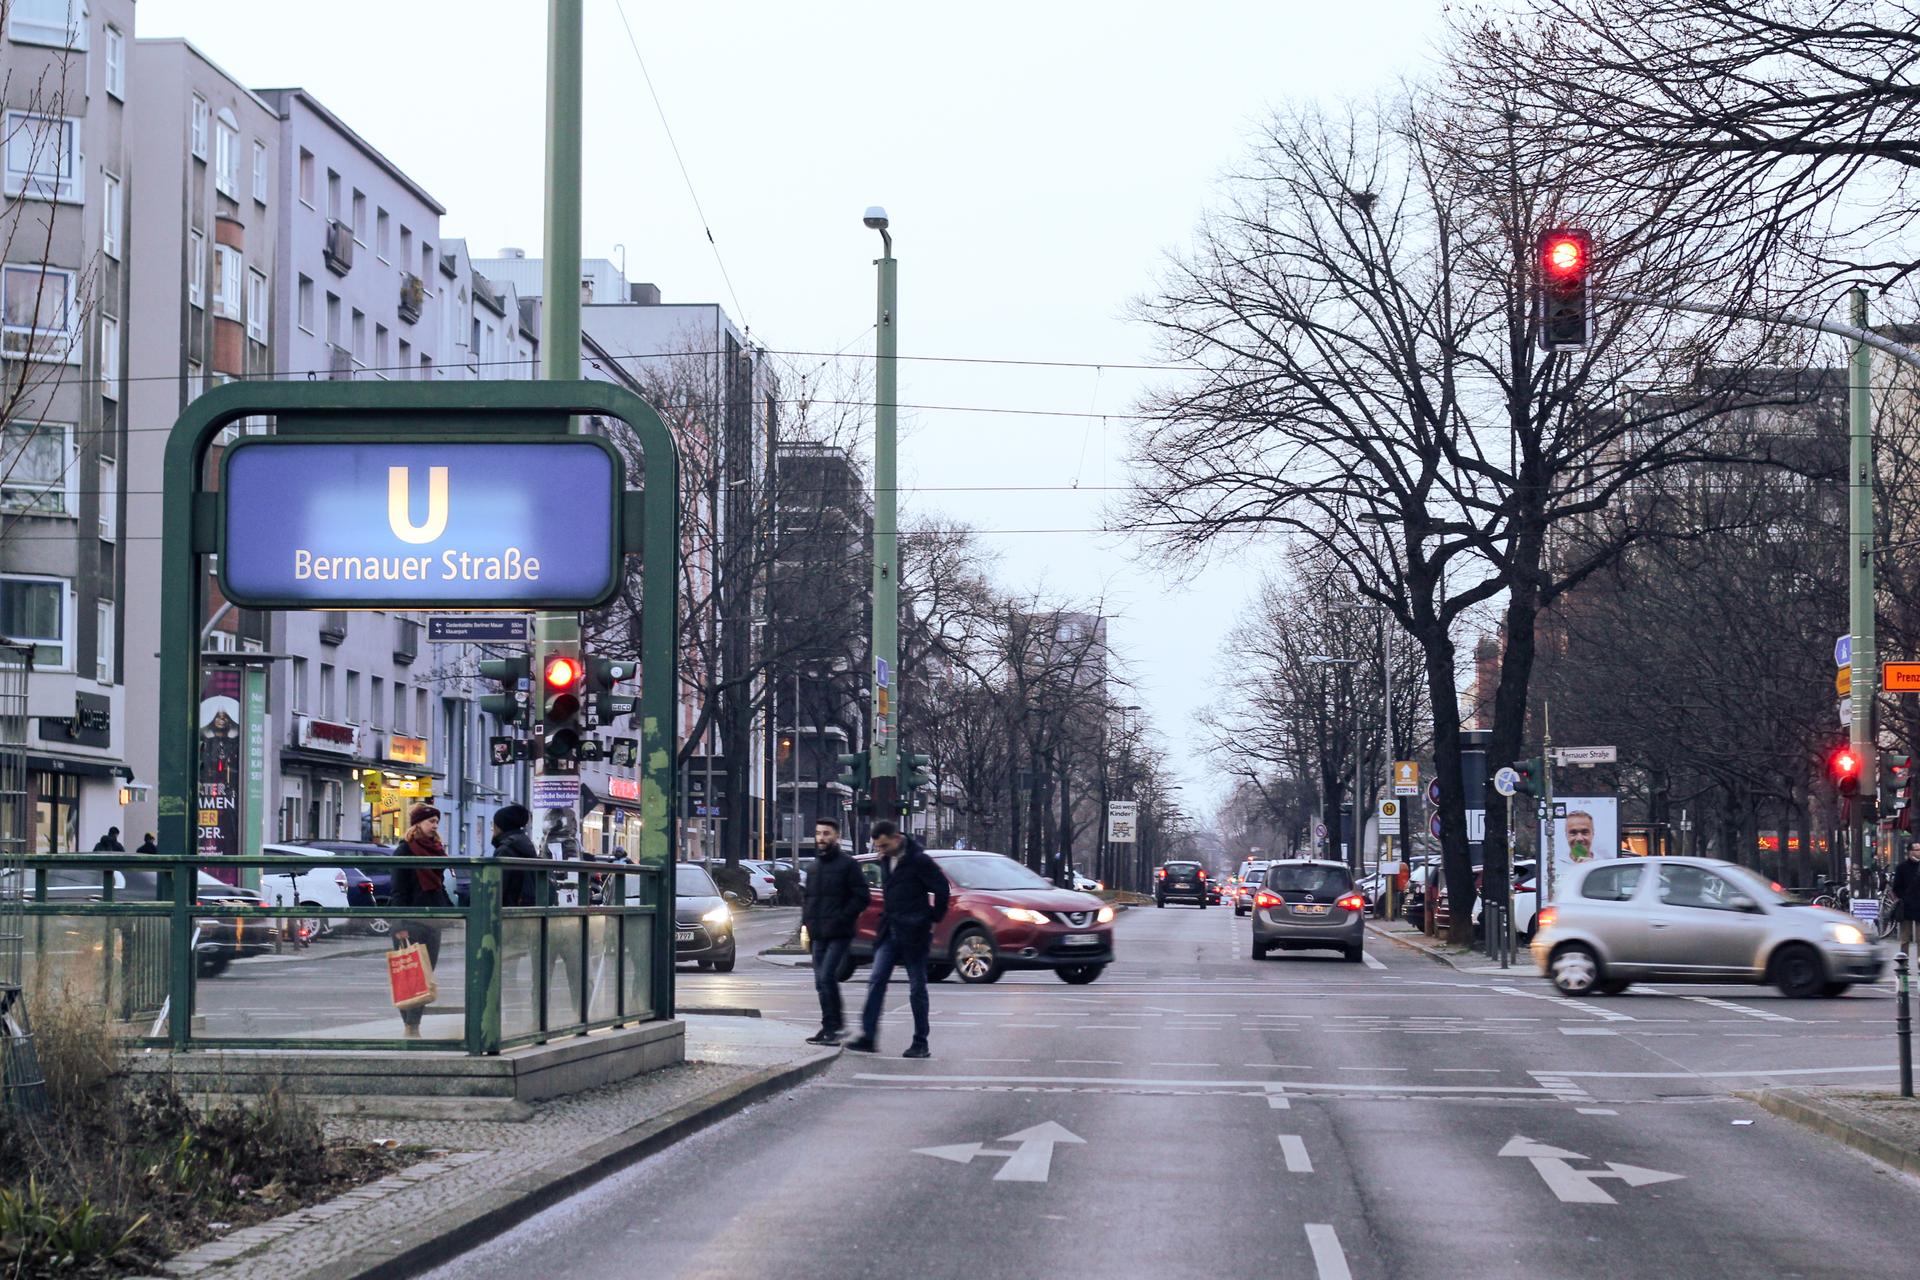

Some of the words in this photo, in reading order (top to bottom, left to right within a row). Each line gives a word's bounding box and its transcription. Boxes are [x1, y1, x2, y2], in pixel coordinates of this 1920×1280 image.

[388, 466, 448, 545] U
[294, 549, 432, 580] Bernauer
[441, 547, 540, 580] Straße
